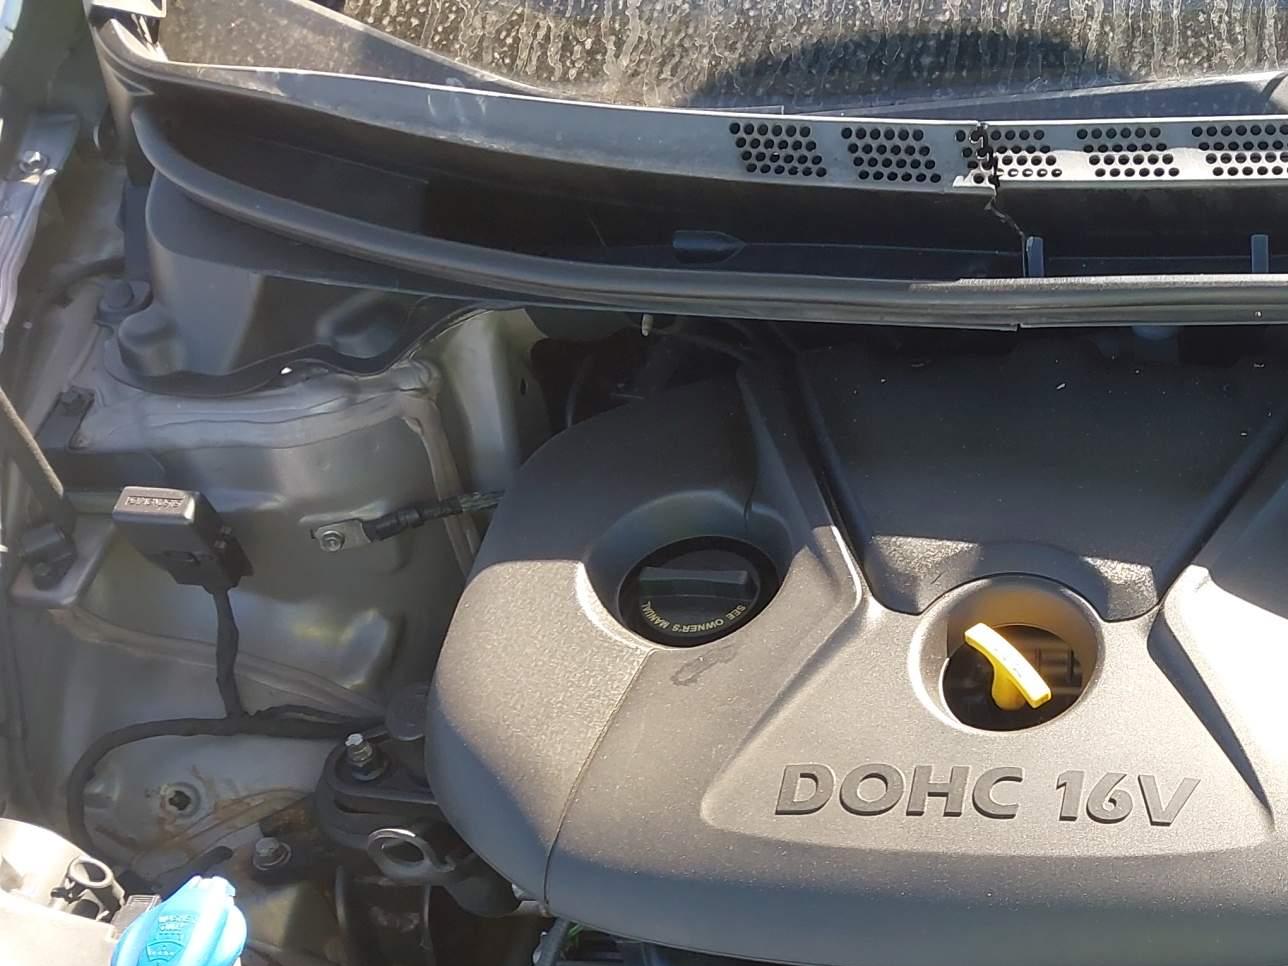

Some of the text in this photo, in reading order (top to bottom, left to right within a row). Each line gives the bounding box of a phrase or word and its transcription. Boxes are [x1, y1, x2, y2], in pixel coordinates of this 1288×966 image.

[641, 601, 746, 632] SEE OWNER'S MANUAL
[774, 763, 1201, 827] DOHC 16V
